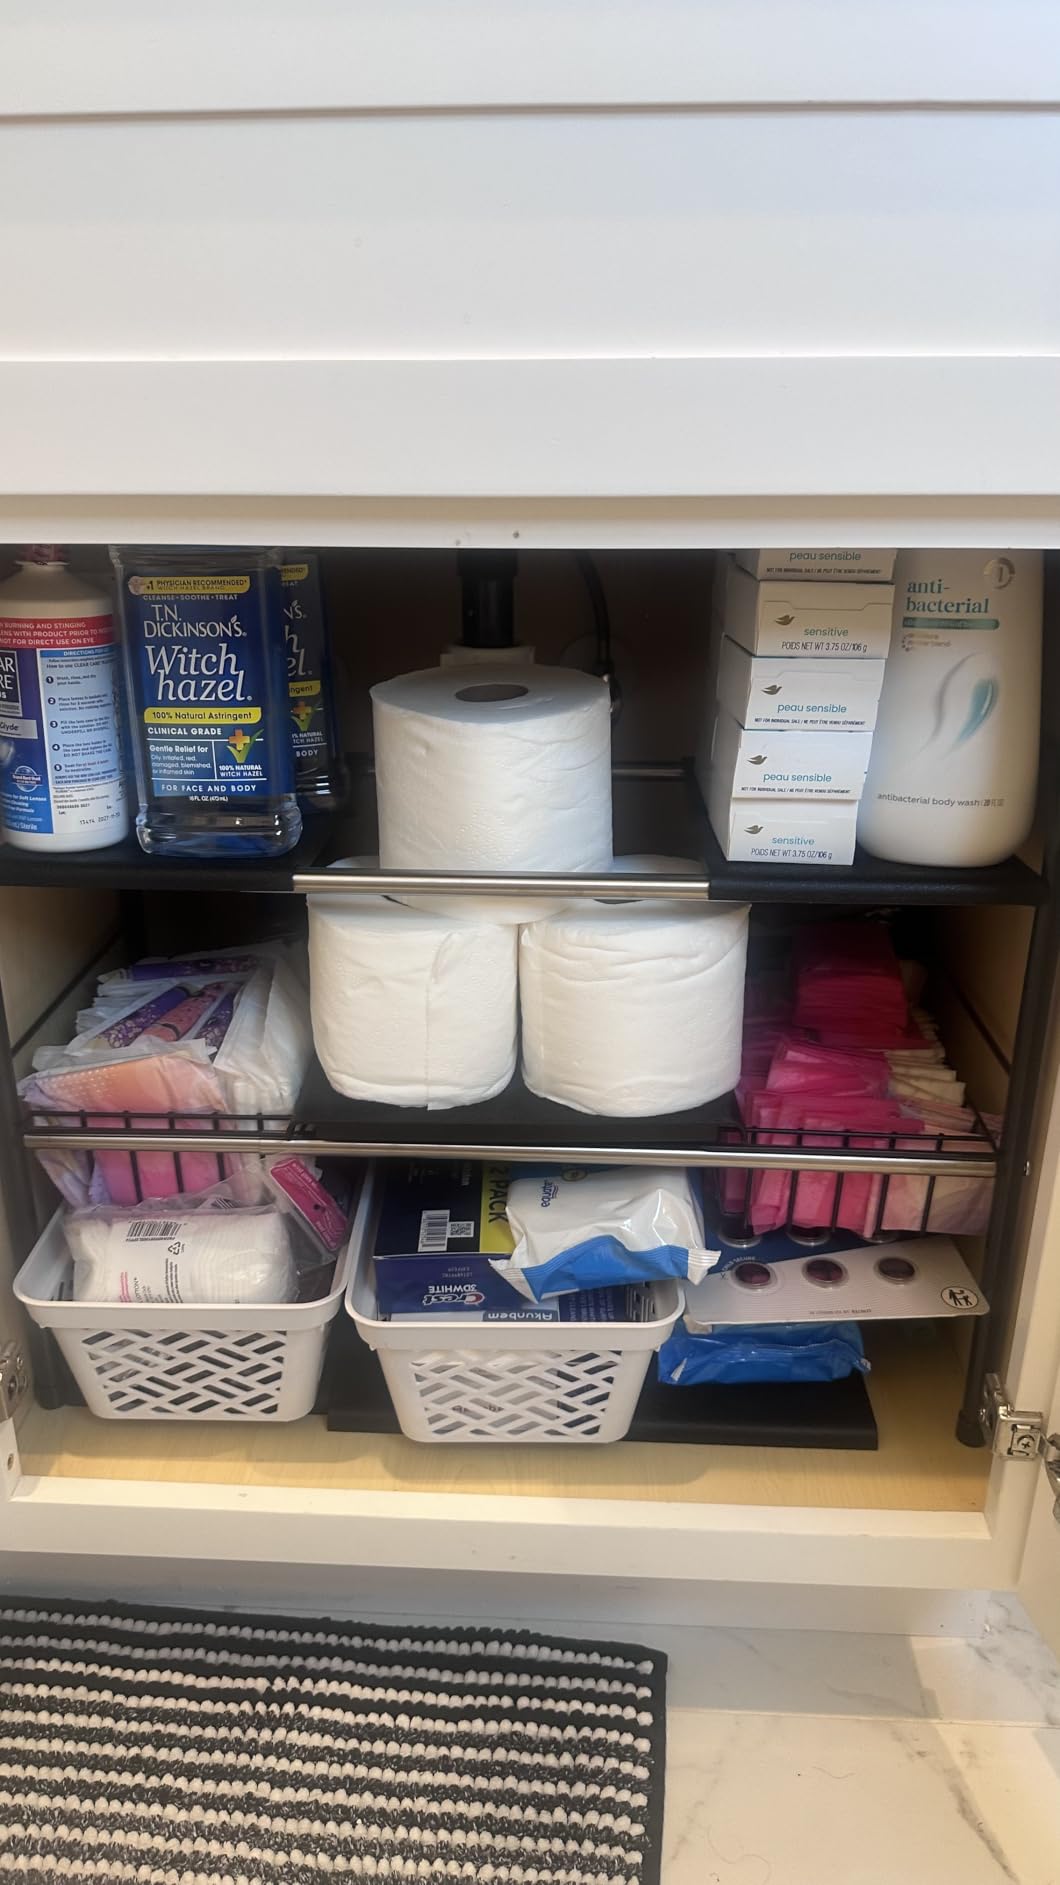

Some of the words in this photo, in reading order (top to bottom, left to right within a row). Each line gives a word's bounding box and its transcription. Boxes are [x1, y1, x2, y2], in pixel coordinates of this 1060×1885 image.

[790, 552, 816, 561] peau
[819, 551, 861, 560] sensible
[907, 579, 950, 593] anti-
[906, 597, 989, 613] bacterial
[151, 604, 182, 621] T.N.
[804, 628, 848, 637] sensitive
[782, 642, 800, 650] POIDS
[801, 642, 813, 650] NET
[815, 642, 824, 650] WT
[825, 643, 839, 651] 3.75
[145, 643, 240, 675] Witch
[778, 704, 803, 713] peau
[806, 703, 847, 713] sensible
[208, 711, 252, 721] Astringent
[148, 727, 188, 735] CLINICAL
[150, 745, 173, 753] Gentle
[176, 745, 196, 753] Relief
[763, 773, 789, 782] peau
[792, 773, 832, 782] sensible
[878, 793, 929, 804] antibacterial
[932, 798, 955, 807] body
[772, 837, 815, 846] sensitive
[751, 848, 769, 856] POIDS
[770, 849, 781, 857] NET
[782, 849, 791, 857] WT
[792, 850, 806, 858] 3.75
[488, 1182, 509, 1223] PACK
[422, 1291, 485, 1305] Crest
[488, 1312, 553, 1321] Akunbem
